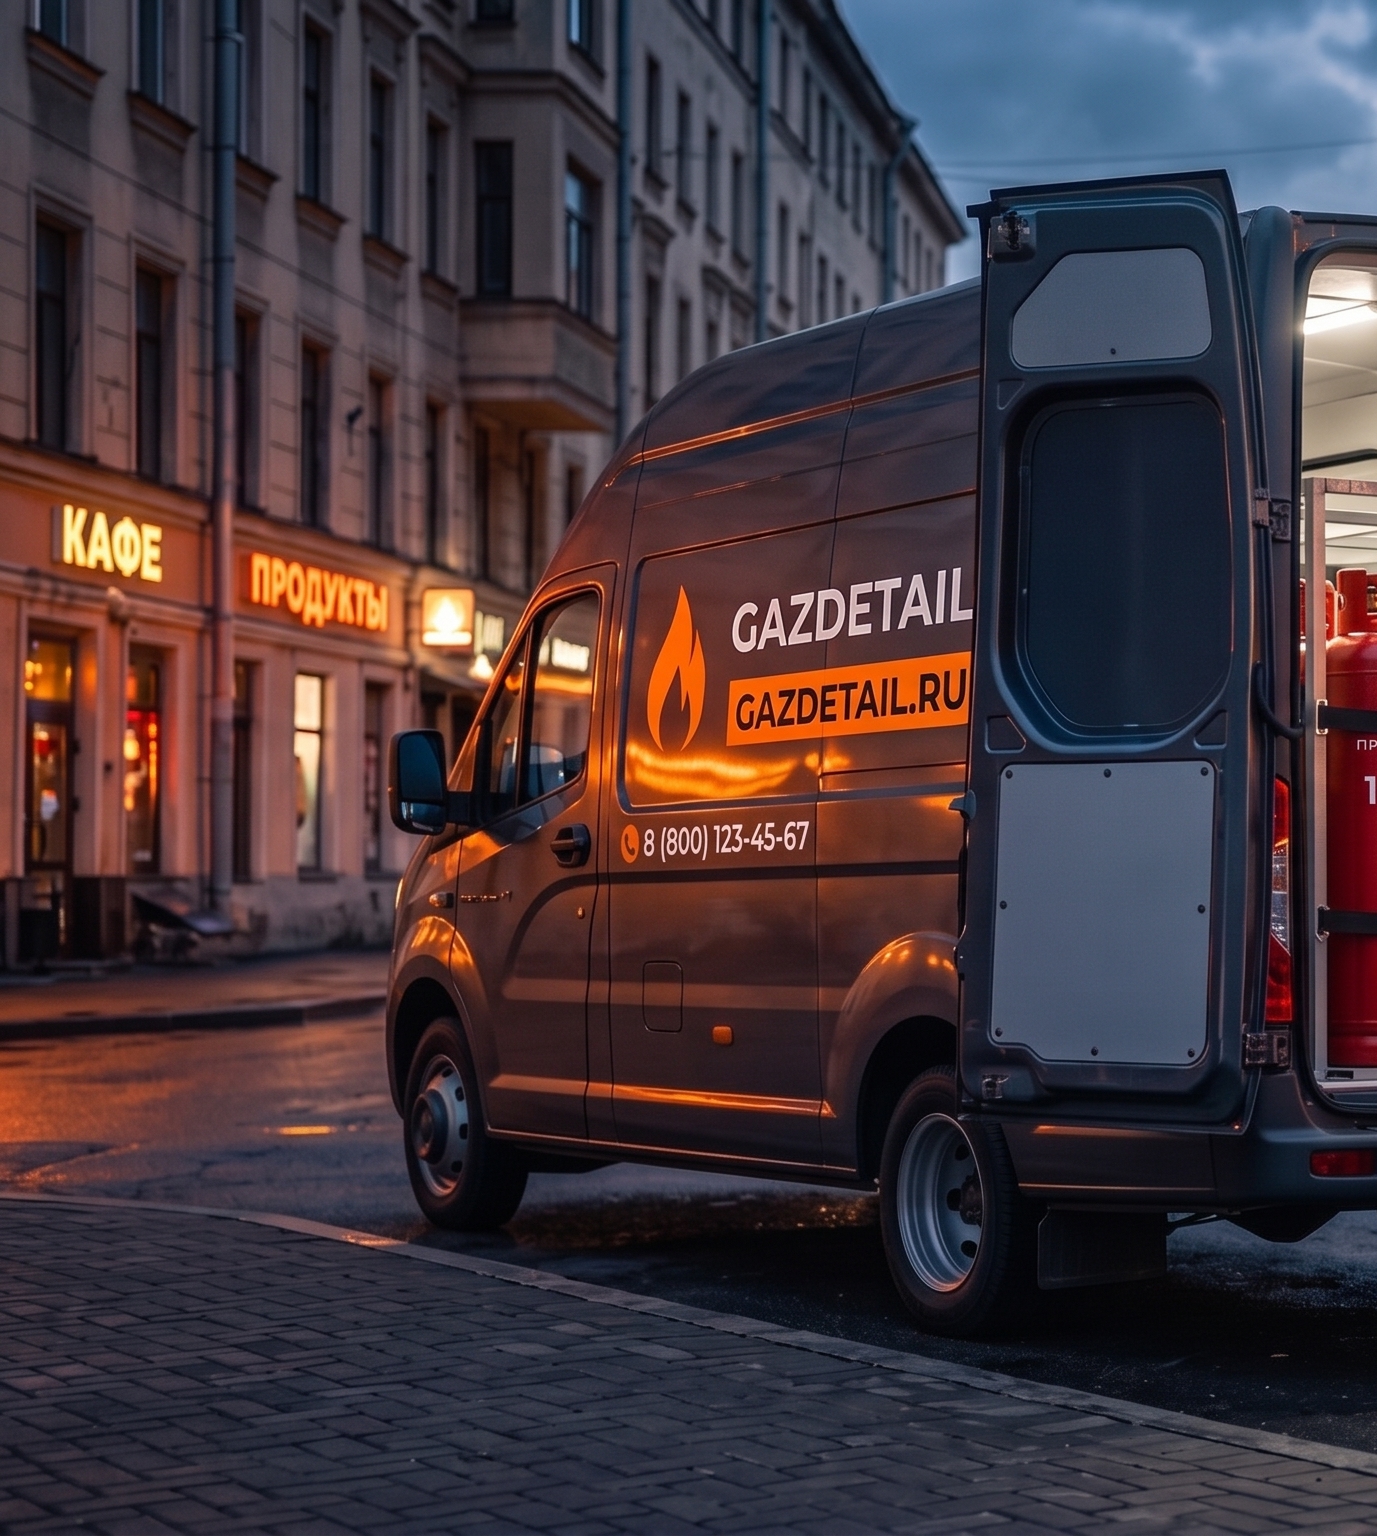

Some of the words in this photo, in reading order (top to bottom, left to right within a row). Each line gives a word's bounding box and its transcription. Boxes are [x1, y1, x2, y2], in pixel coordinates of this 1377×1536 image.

[62, 504, 163, 582] КАФЕ
[249, 552, 389, 632] ПРОДУКТЫ
[731, 567, 974, 654] GAZDETAIL
[735, 668, 968, 732] GAZDETAIL.RU
[643, 829, 655, 857] 8
[660, 825, 708, 862] (800)
[713, 821, 810, 854] 123-45-67
